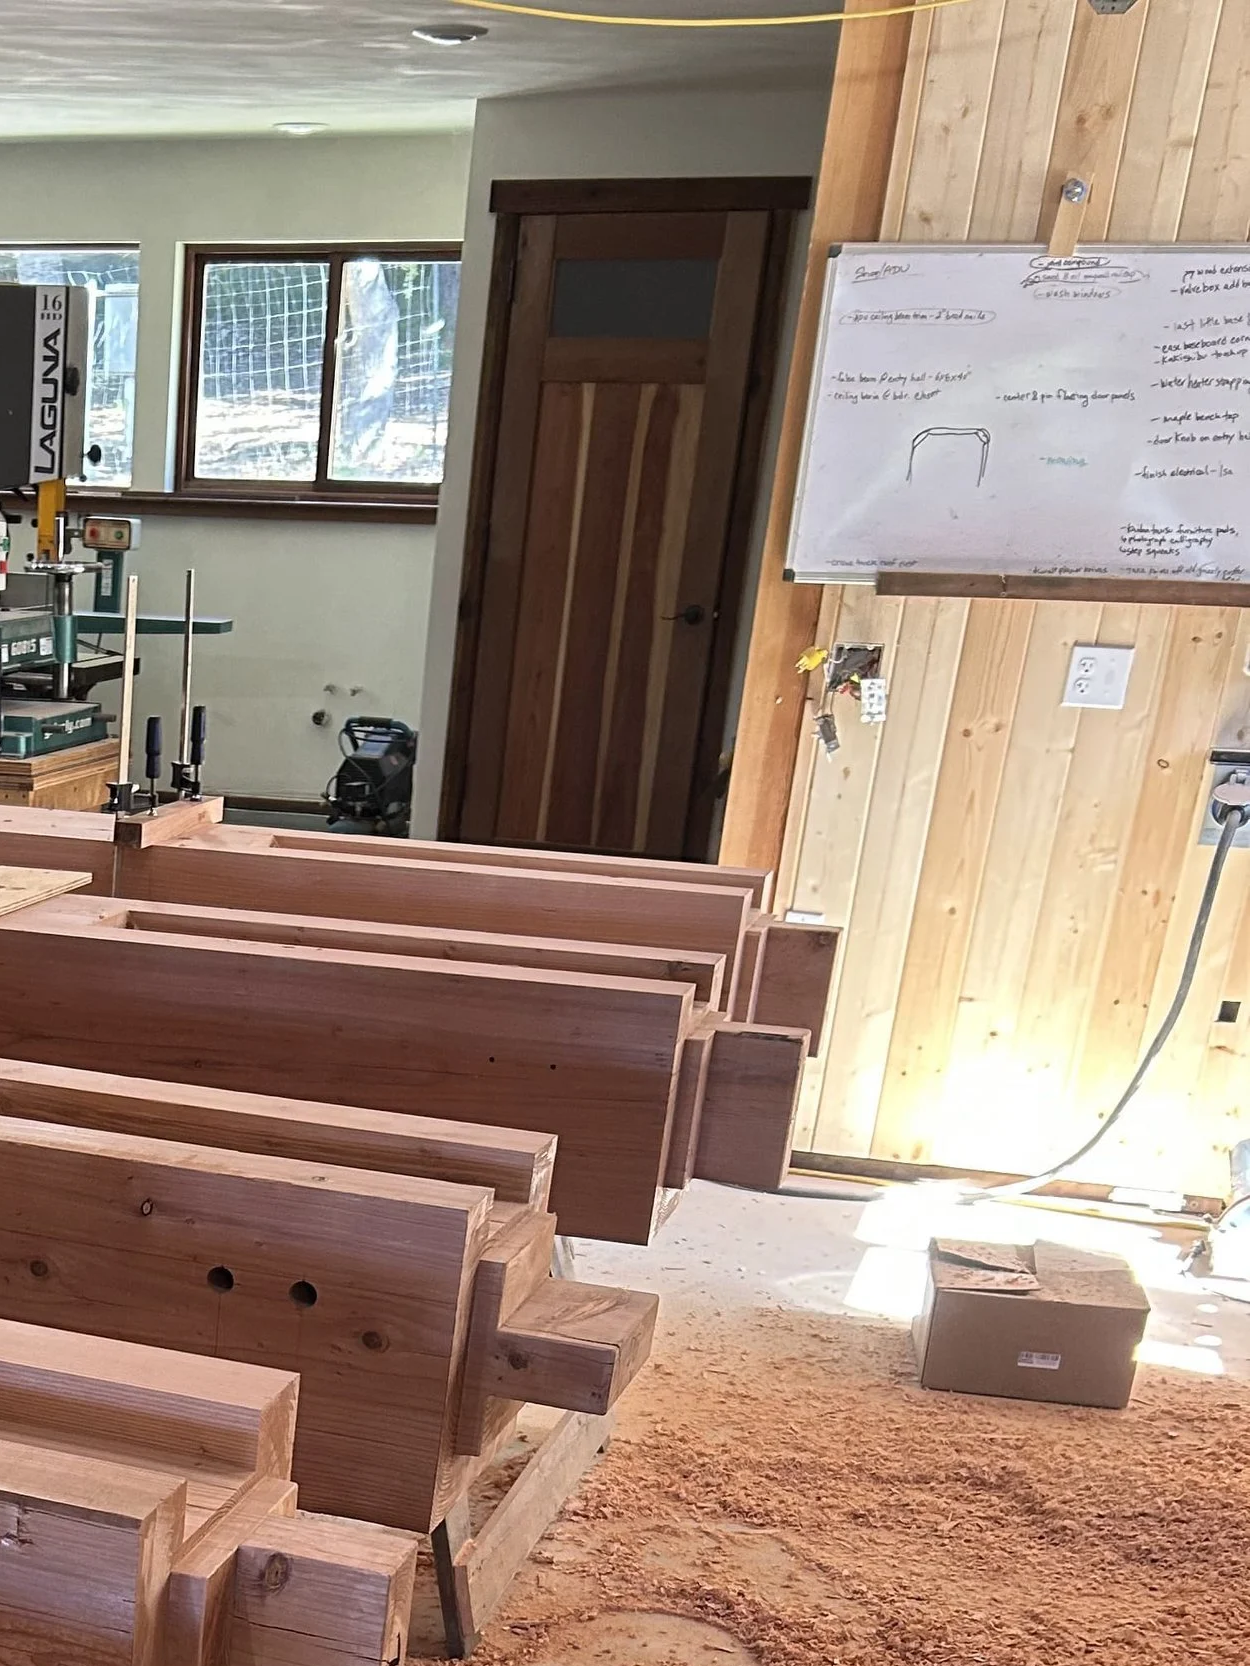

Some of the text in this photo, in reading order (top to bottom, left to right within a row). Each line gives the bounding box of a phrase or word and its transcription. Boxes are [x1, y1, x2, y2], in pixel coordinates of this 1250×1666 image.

[42, 294, 63, 312] 16
[41, 312, 63, 321] HD
[34, 327, 61, 475] LAGUNA
